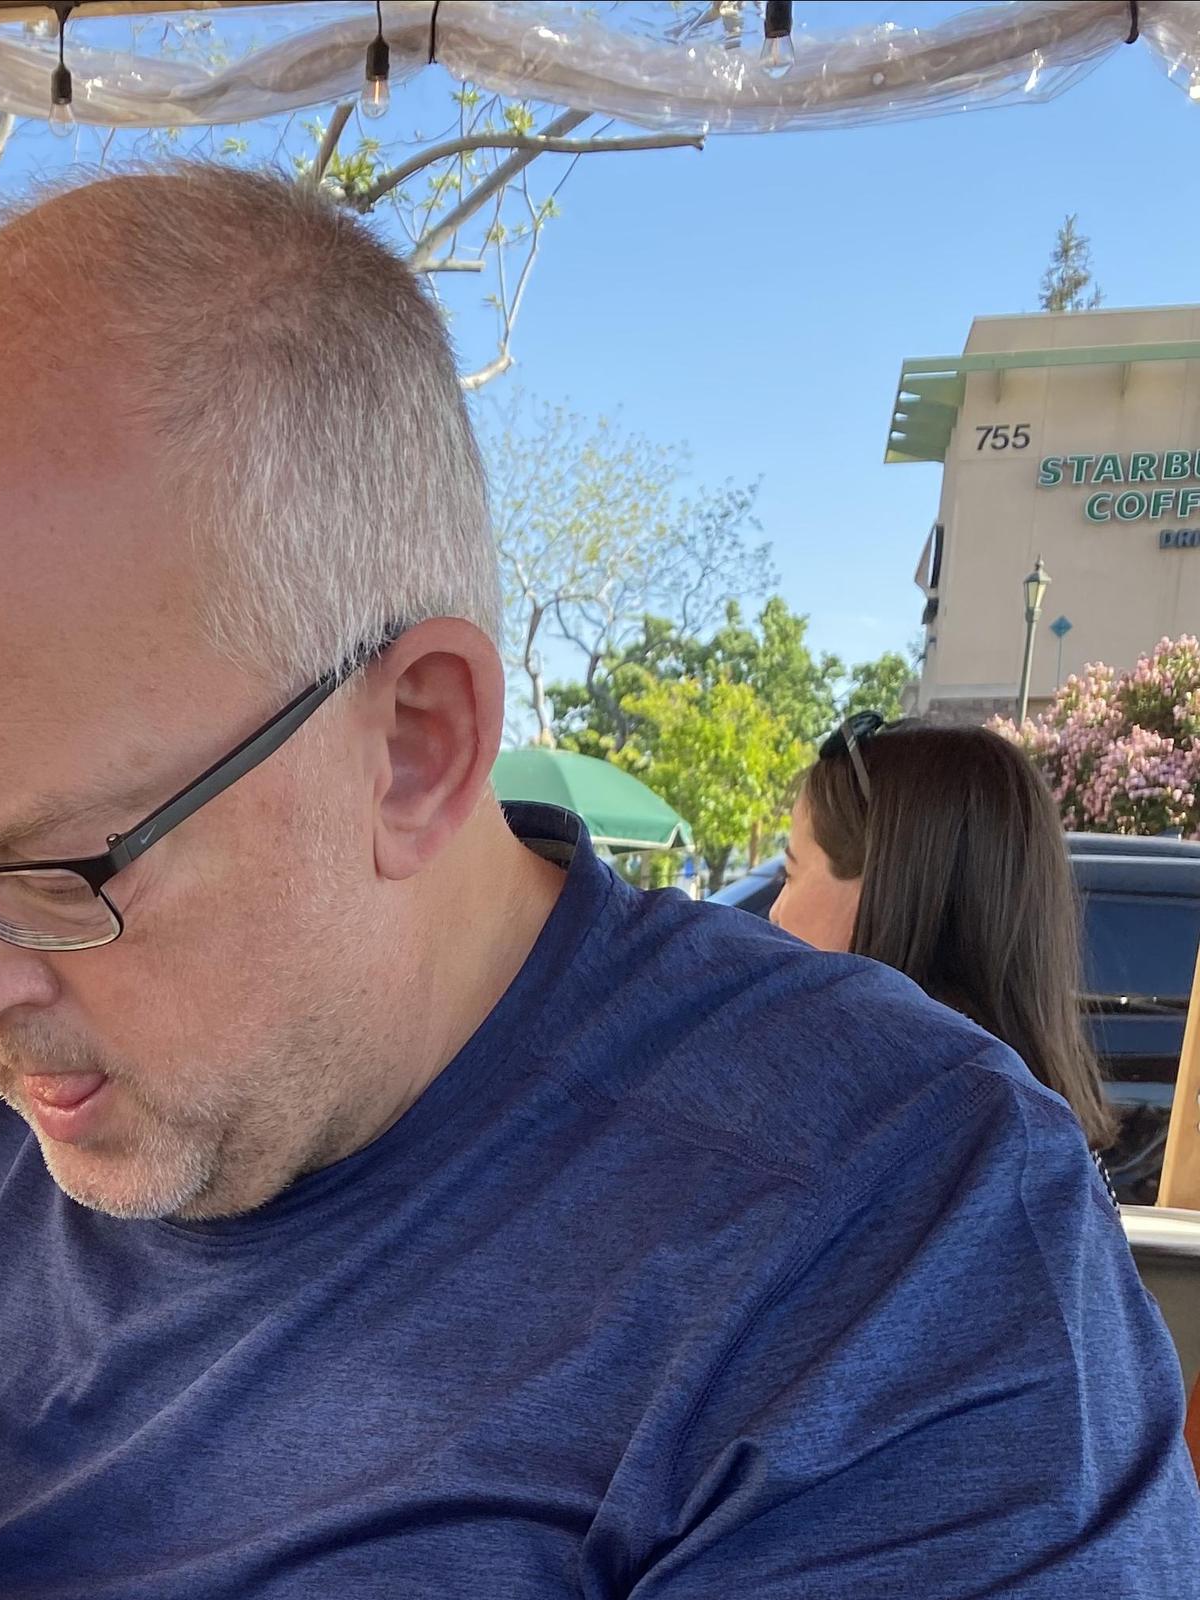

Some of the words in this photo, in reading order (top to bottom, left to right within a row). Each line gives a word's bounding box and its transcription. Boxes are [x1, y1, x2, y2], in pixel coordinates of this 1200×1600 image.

[975, 424, 1031, 451] 755
[1038, 448, 1200, 487] STARB
[1085, 487, 1200, 522] COFF
